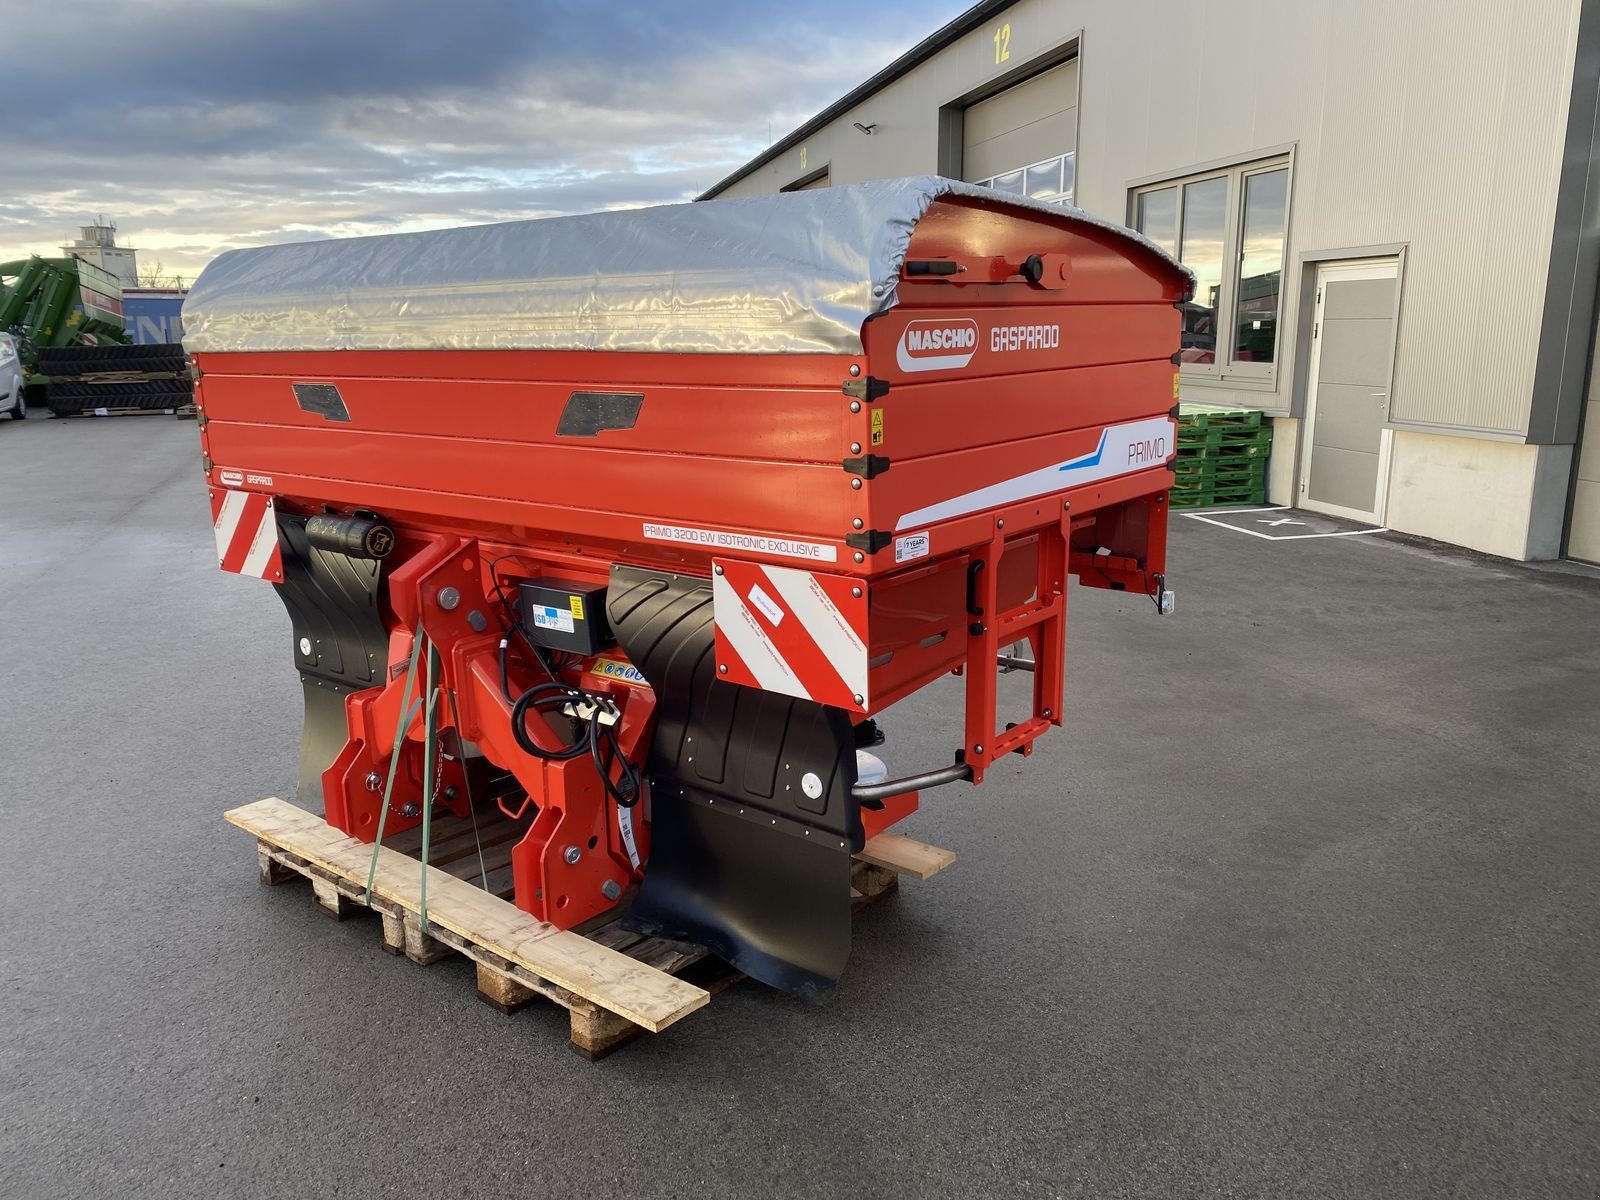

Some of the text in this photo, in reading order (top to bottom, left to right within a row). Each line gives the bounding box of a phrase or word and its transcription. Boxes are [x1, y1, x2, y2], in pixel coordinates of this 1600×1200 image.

[993, 23, 1010, 65] 12
[800, 146, 807, 169] 13
[908, 325, 1060, 352] MASCHIO GASPARDO
[1127, 437, 1165, 466] PRIMO
[644, 525, 820, 557] PRIMO 3200 EW ISOTRONIC EXCLUSIVE
[910, 539, 925, 548] YEARS
